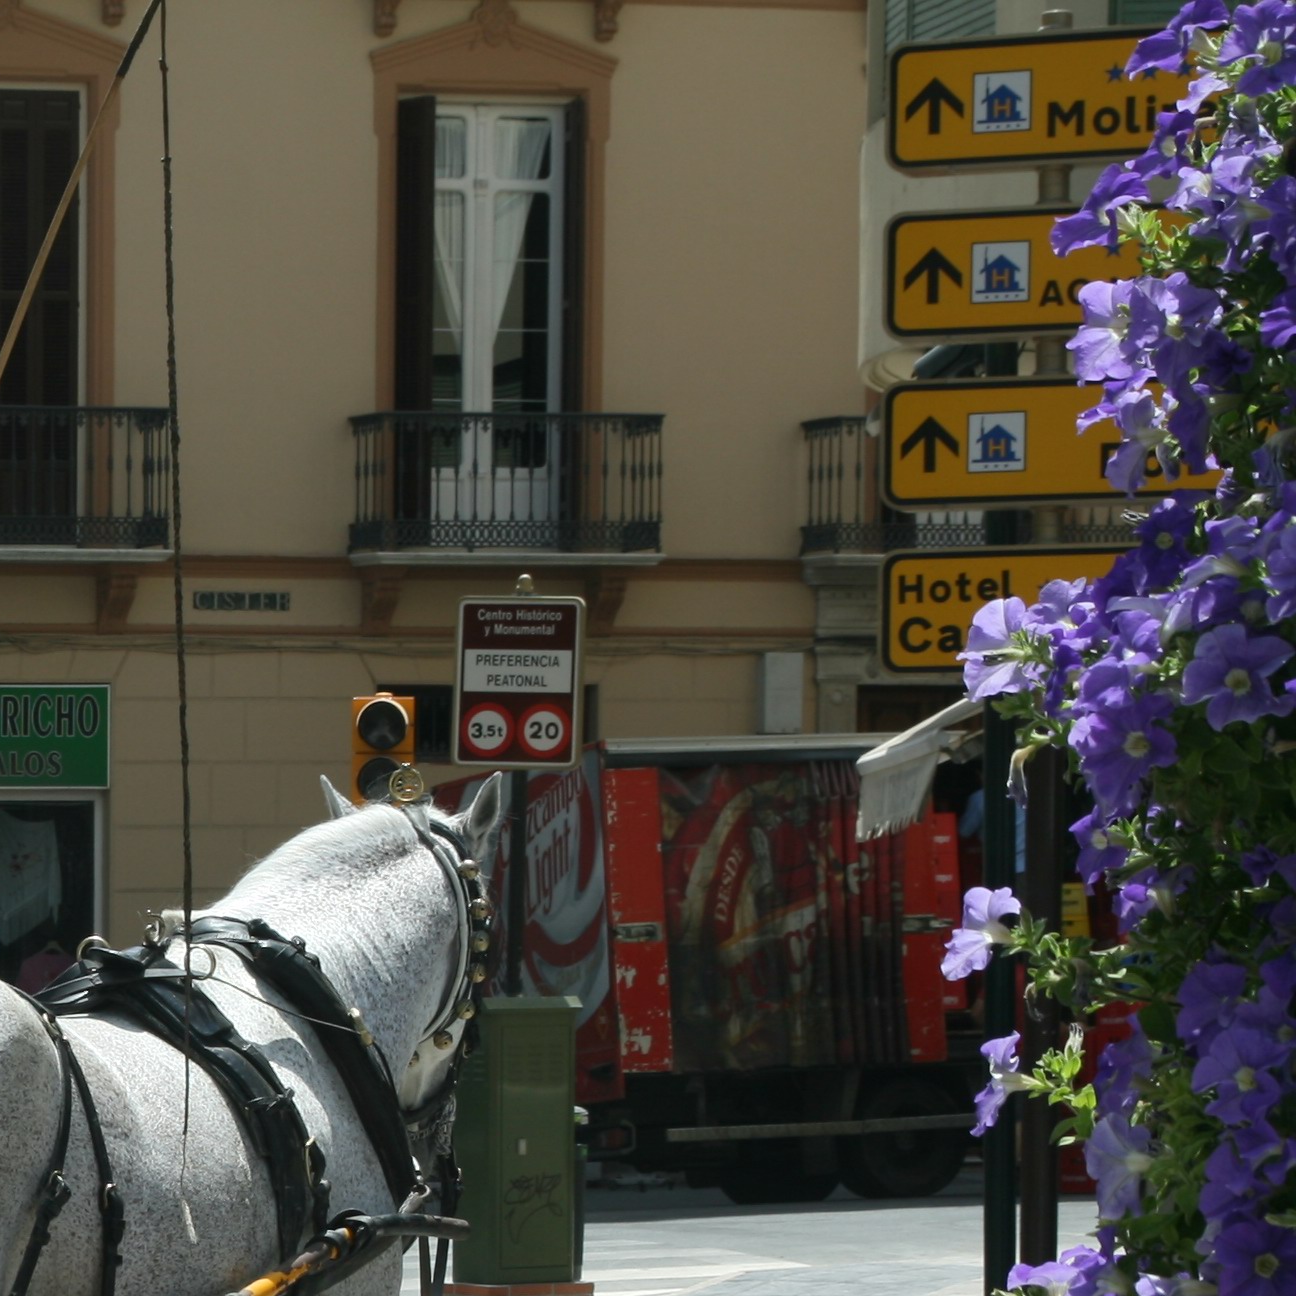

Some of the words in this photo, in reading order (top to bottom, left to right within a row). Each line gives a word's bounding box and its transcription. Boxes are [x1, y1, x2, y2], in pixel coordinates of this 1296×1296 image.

[898, 570, 1013, 604] Hotel
[477, 608, 513, 621] Centro
[516, 609, 563, 621] Histórico
[484, 626, 491, 637] y
[493, 623, 556, 635] Monumental
[475, 654, 561, 668] PREFERENCIA
[486, 674, 548, 688] PEATONAL
[529, 721, 559, 740] 20
[524, 817, 570, 920] Light
[715, 846, 745, 923] DESDE
